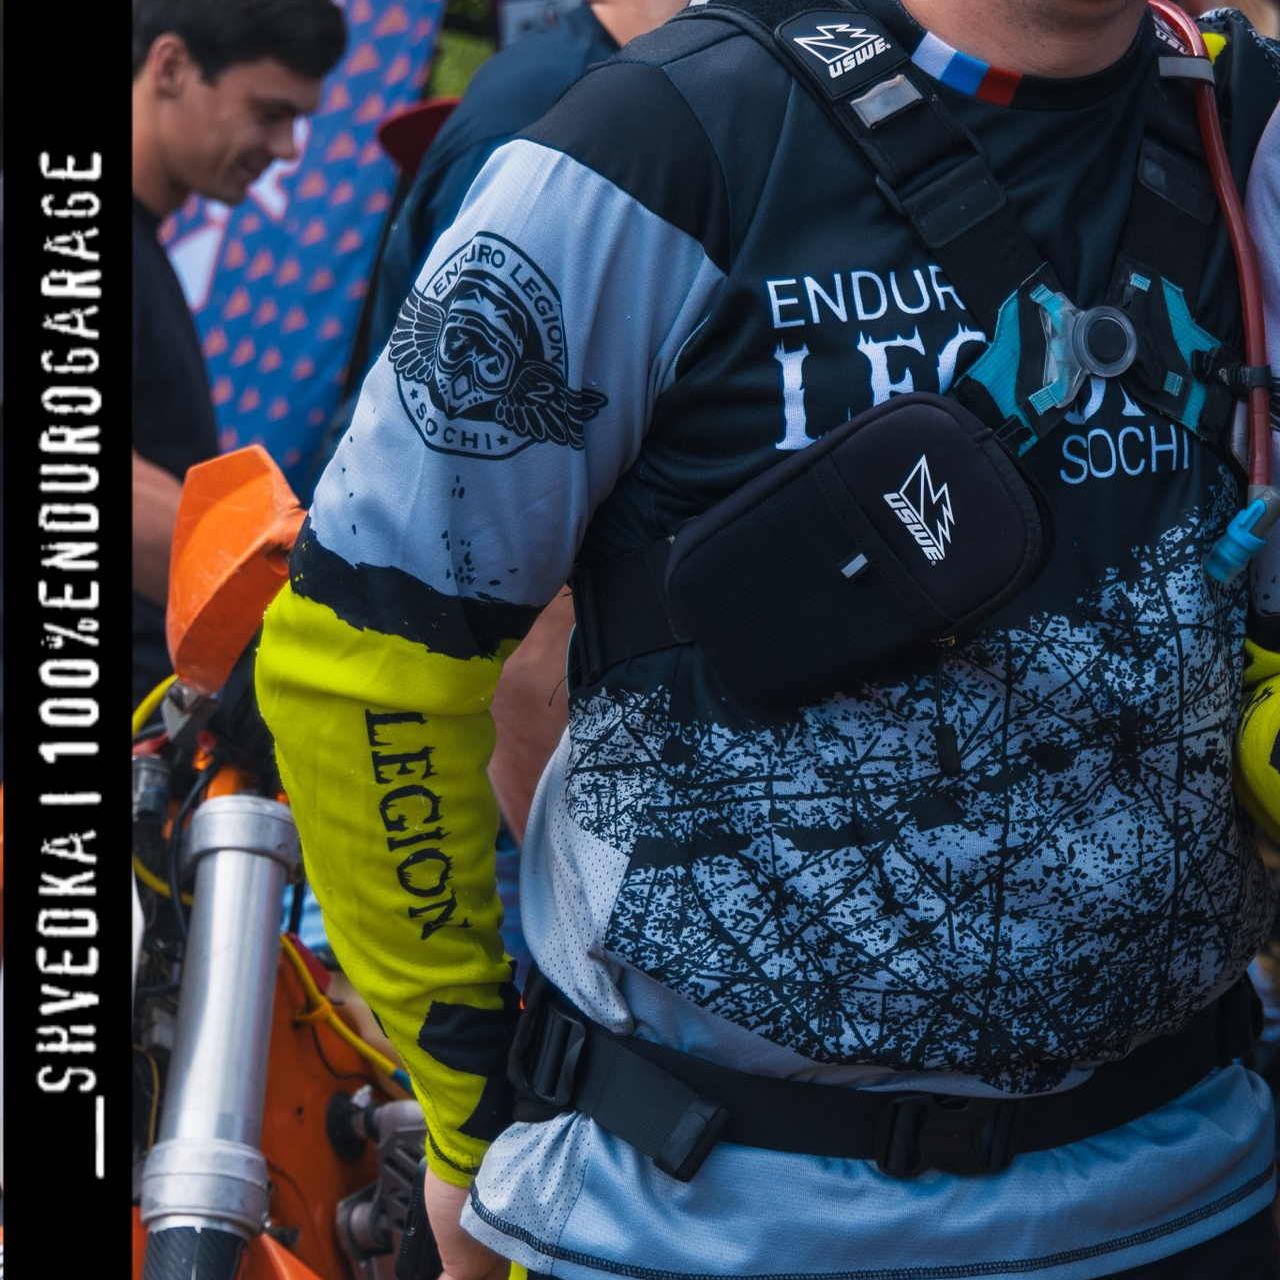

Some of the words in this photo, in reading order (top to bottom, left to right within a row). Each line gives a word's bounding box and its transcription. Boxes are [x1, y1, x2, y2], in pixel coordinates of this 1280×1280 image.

[829, 38, 890, 79] USWE
[433, 244, 506, 298] ENURO
[509, 263, 564, 366] LEGION
[765, 264, 967, 329] ENDUR
[415, 402, 493, 451] SOCHI
[1060, 423, 1190, 485] SOCHI
[883, 490, 943, 563] USWE
[364, 707, 472, 941] LEGION
